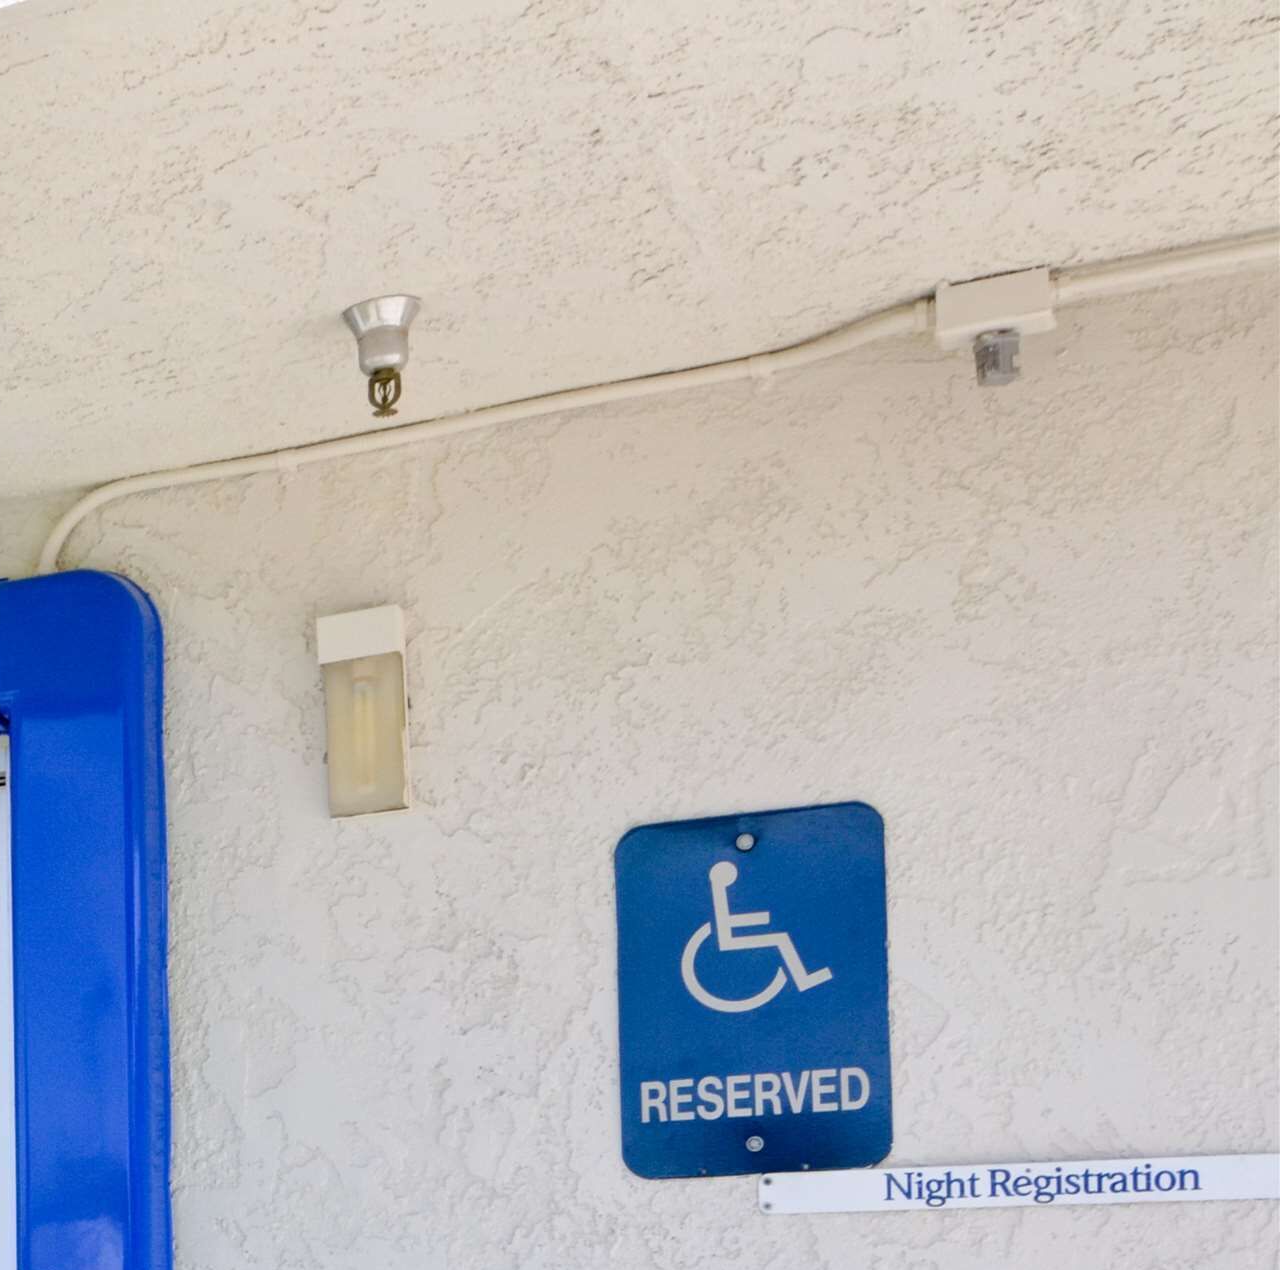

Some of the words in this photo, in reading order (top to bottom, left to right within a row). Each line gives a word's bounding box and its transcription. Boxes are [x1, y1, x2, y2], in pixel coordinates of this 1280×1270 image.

[640, 1066, 871, 1124] RESERVED
[883, 1170, 981, 1208] Night
[986, 1163, 1203, 1203] Registration
